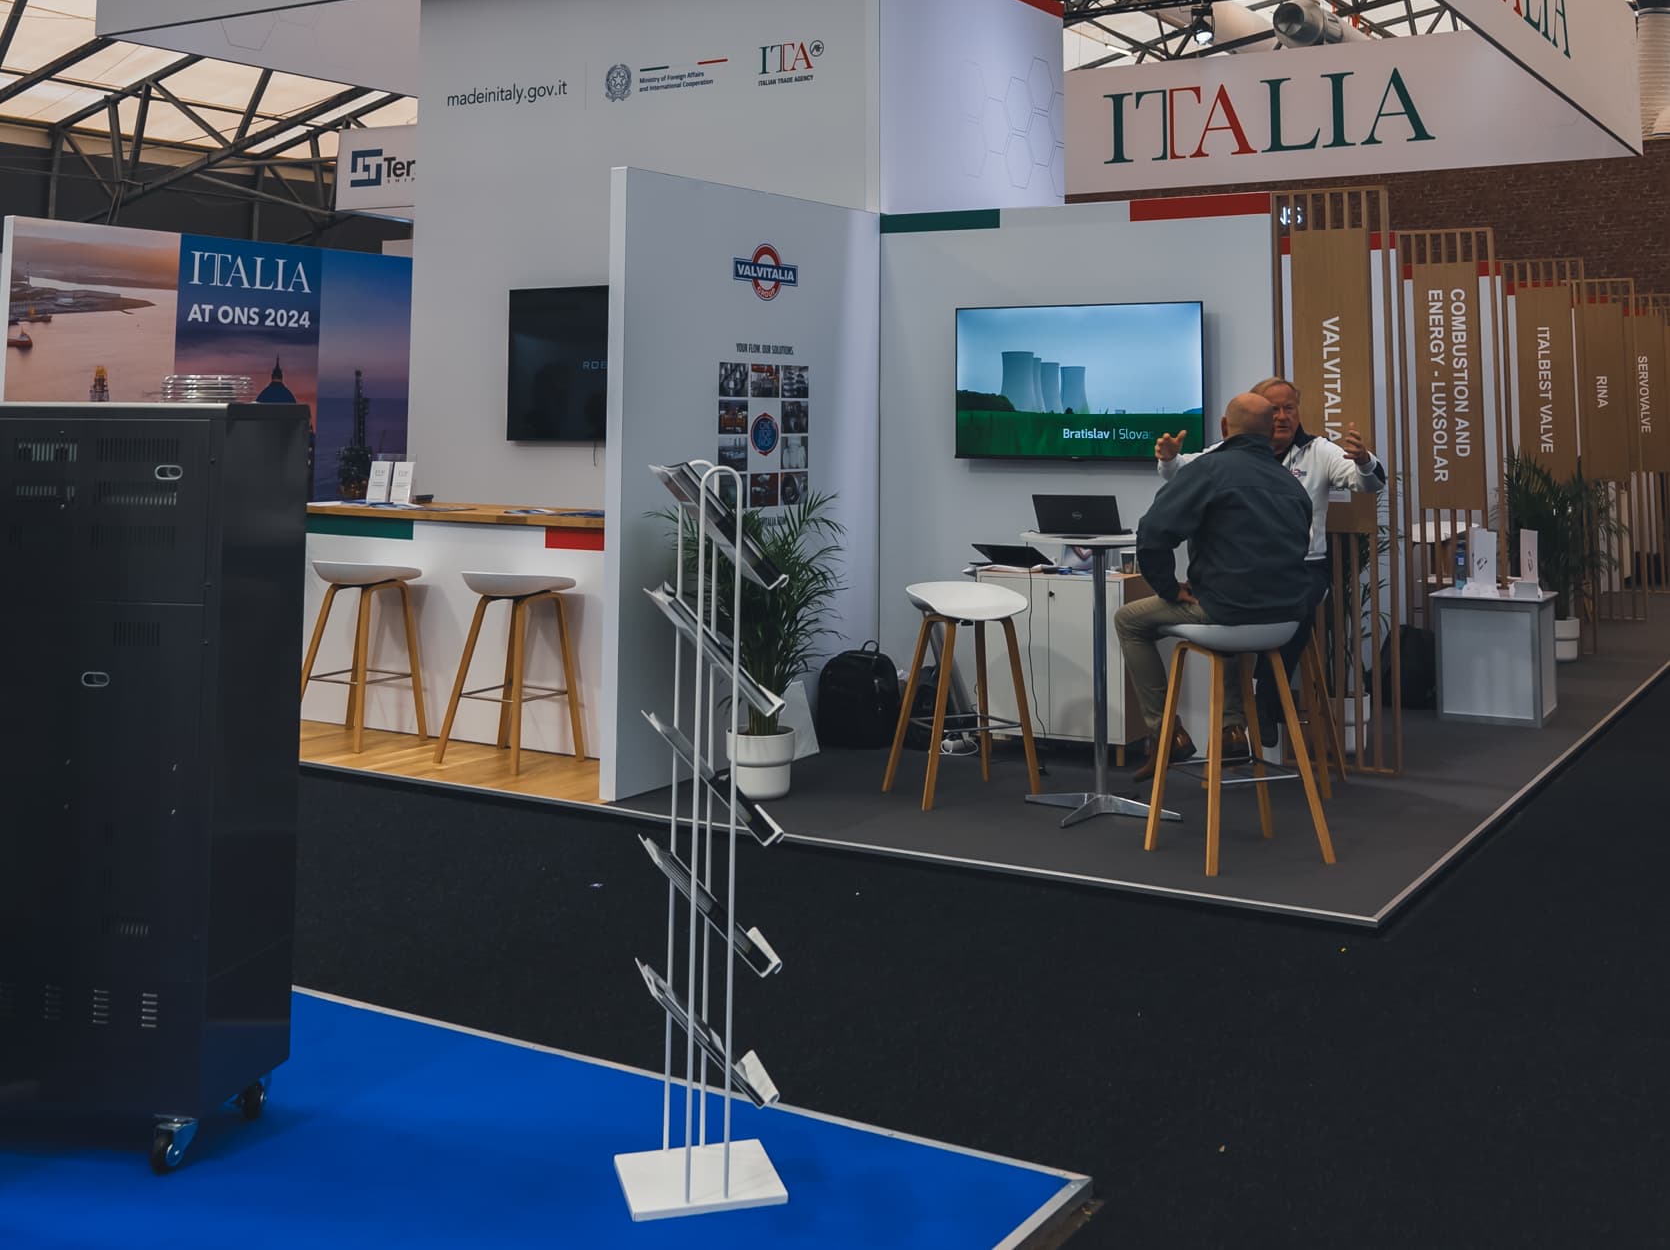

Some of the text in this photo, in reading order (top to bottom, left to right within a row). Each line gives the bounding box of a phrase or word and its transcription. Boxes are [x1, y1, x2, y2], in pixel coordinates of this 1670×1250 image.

[758, 42, 813, 75] ITA
[447, 80, 568, 106] madeinitaly.gov.it
[1103, 67, 1436, 165] ITALIA
[188, 250, 312, 294] ITALIA
[737, 263, 795, 281] VALVITALIA
[187, 303, 311, 328] AT ONS 2024
[1428, 289, 1446, 366] ENERGY
[1322, 316, 1342, 442] VALVITALIA
[1450, 288, 1471, 458] COMBUSTION AND
[1537, 326, 1554, 454] ITALBEST VALVE
[1596, 375, 1609, 409] RINA
[1638, 355, 1652, 434] SERVOVALVE
[1063, 427, 1110, 439] Bratislav
[1431, 382, 1449, 483] LUXSOLAR
